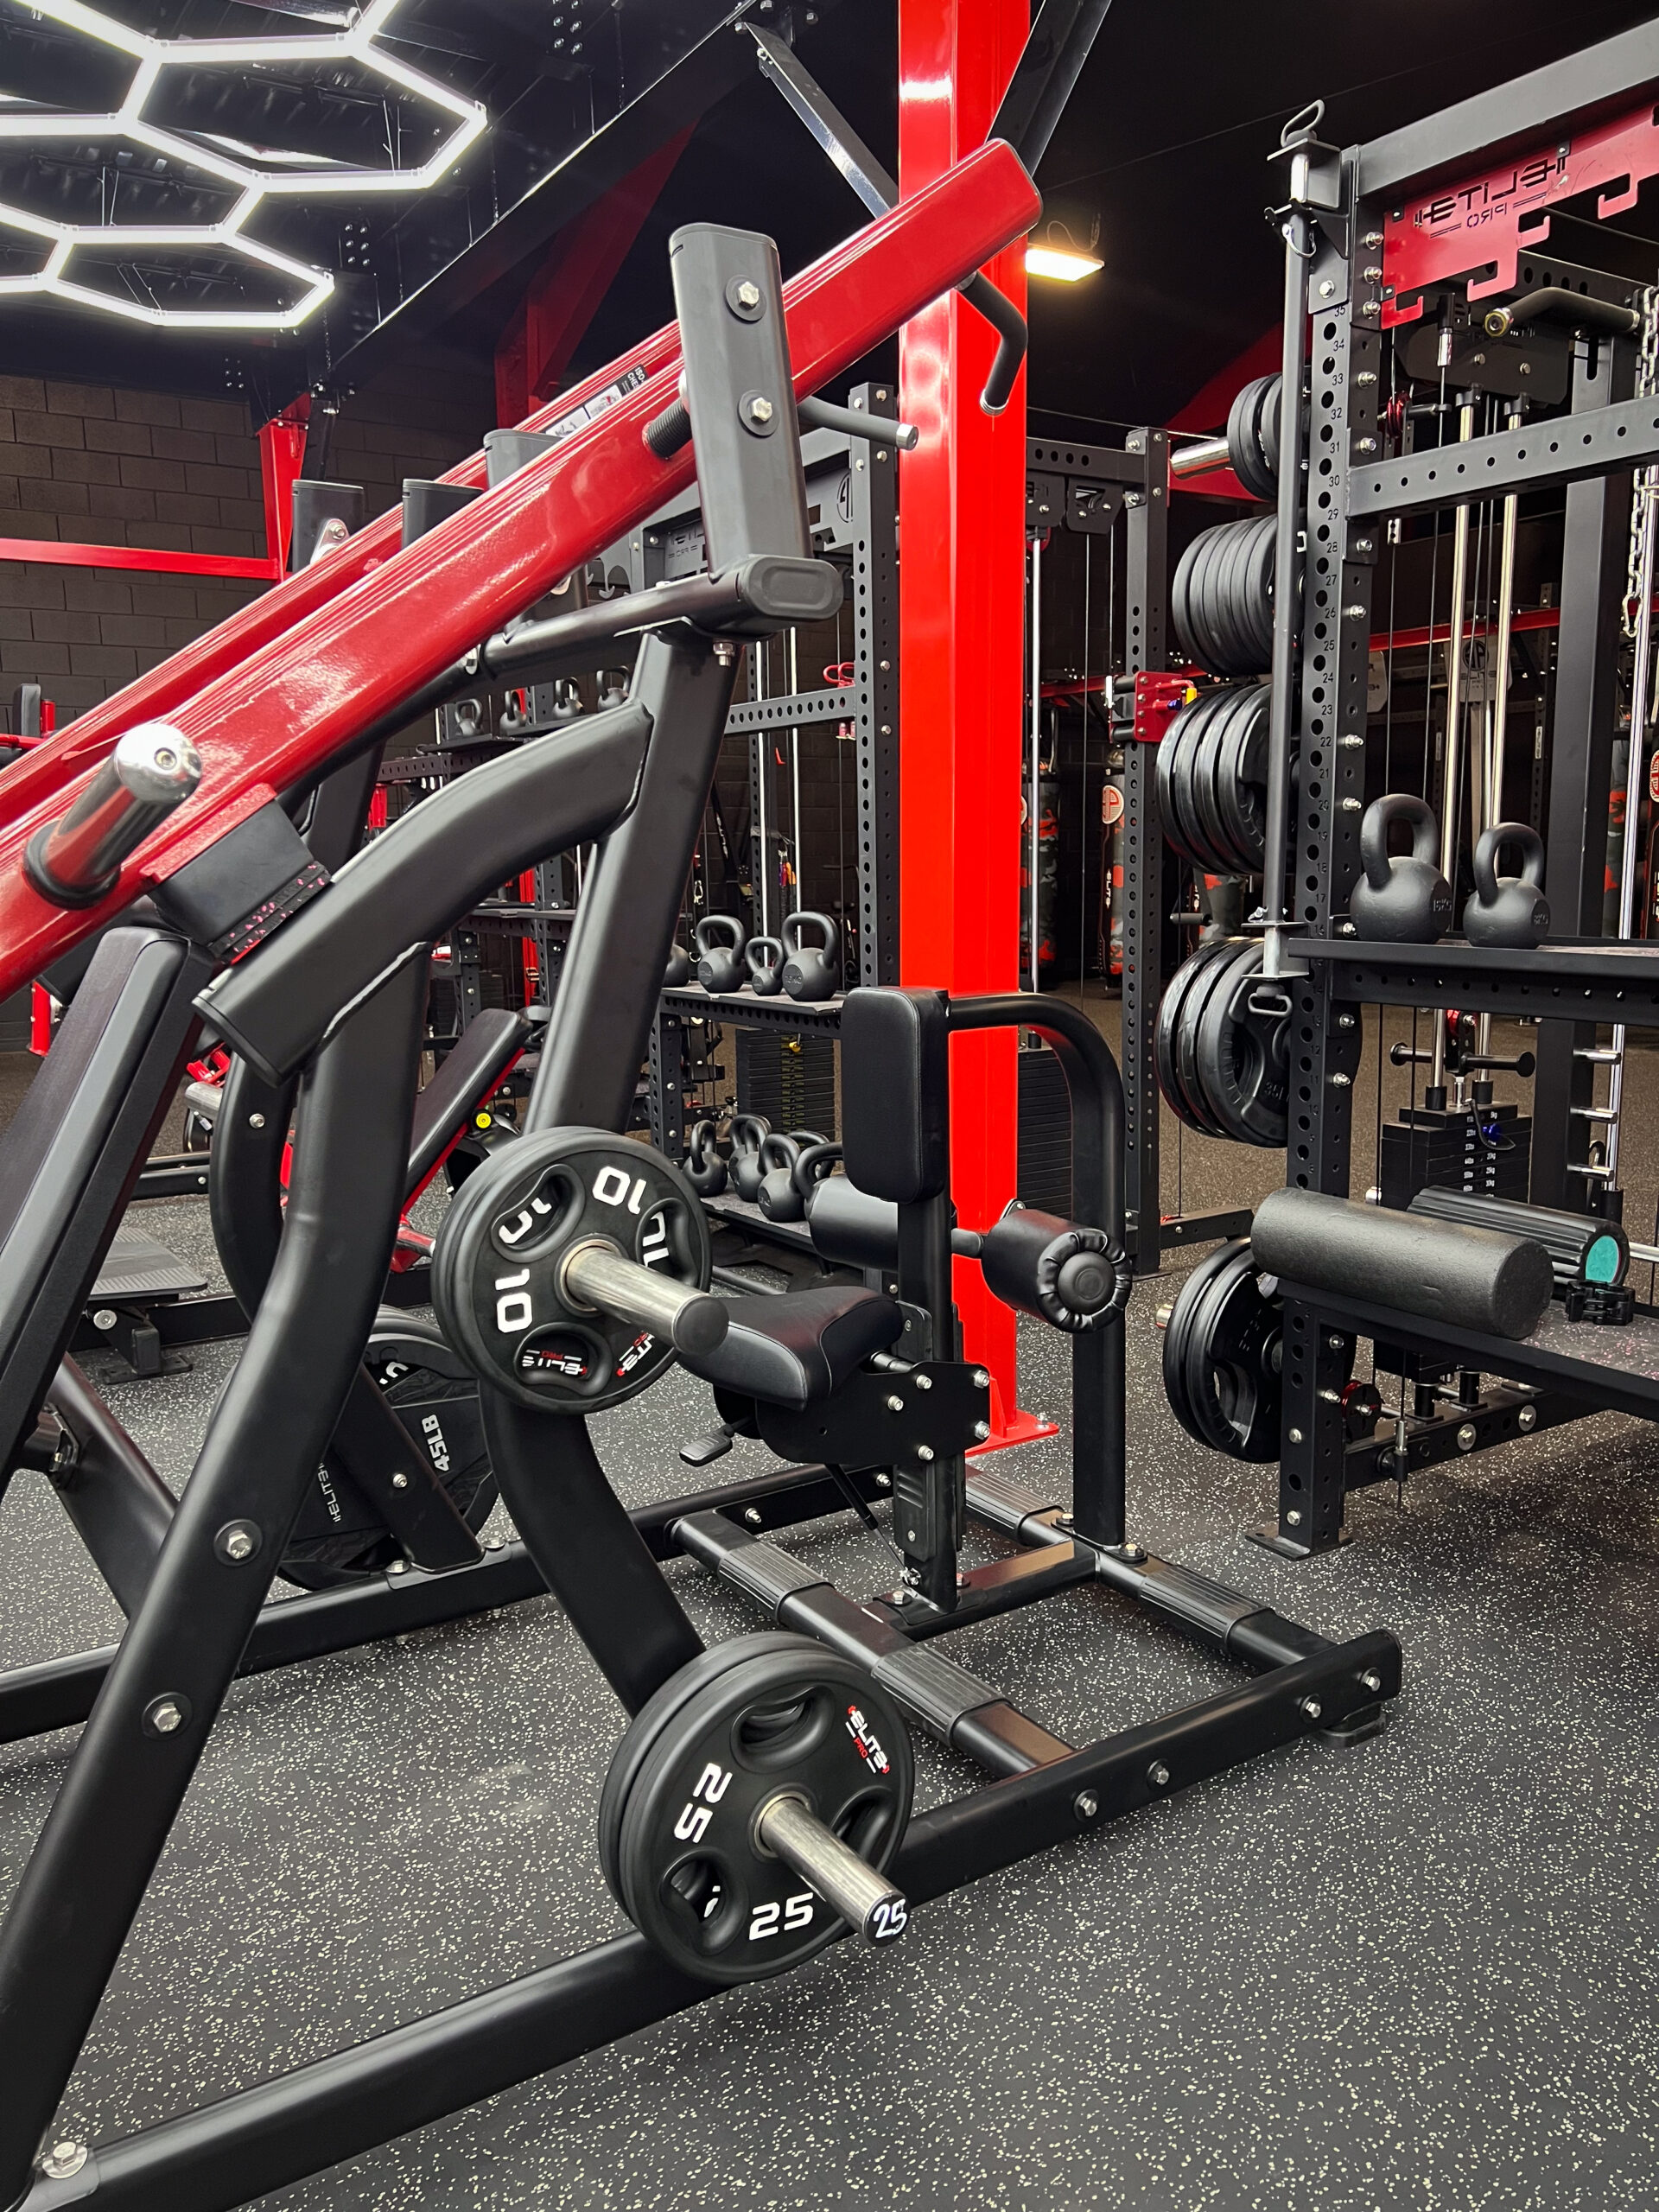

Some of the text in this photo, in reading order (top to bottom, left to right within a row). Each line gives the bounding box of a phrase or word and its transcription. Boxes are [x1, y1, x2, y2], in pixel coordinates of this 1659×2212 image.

[1334, 305, 1345, 317] 35
[1333, 339, 1344, 352] 34
[1332, 372, 1344, 385] 33
[1331, 407, 1342, 420] 32
[1330, 442, 1340, 454] 31
[1328, 474, 1340, 487] 30
[1327, 508, 1339, 521] 29
[1326, 541, 1338, 553] 28
[1325, 575, 1337, 587] 27
[1325, 607, 1336, 620] 26
[1324, 639, 1335, 652] 25
[1322, 671, 1334, 683] 24
[1321, 704, 1333, 715] 23
[1320, 736, 1332, 747] 22
[1319, 768, 1330, 779] 21
[1319, 799, 1330, 811] 20
[1318, 831, 1328, 842] 19
[1315, 893, 1326, 904] 17
[592, 1166, 646, 1215] 10
[494, 1268, 532, 1333] 10
[522, 1354, 584, 1376] ELITE
[421, 1414, 450, 1472] 45LB
[317, 1466, 341, 1522] ELITE
[849, 1706, 890, 1773] ELITE
[852, 1737, 869, 1759] PRO
[673, 1761, 734, 1844] 25
[748, 1891, 814, 1942] 25
[872, 1898, 908, 1939] 25
